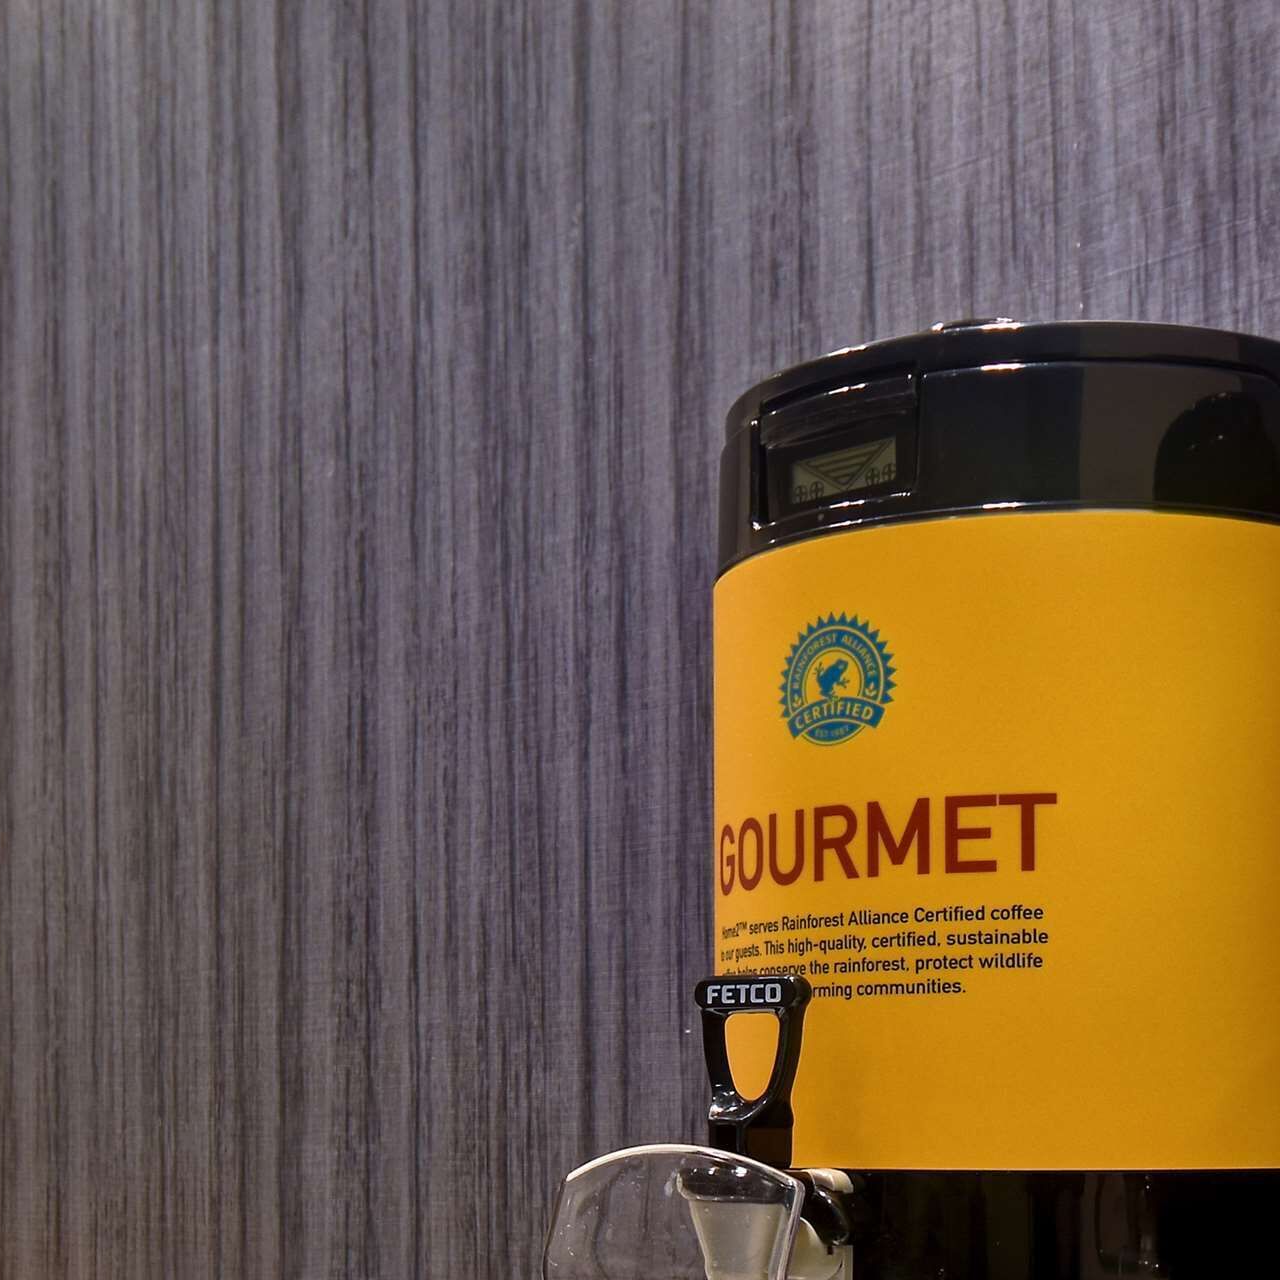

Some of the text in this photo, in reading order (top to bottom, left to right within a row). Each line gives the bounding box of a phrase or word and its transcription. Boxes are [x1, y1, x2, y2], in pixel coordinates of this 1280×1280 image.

[792, 633, 877, 689] RAINFOREST ALLIANCE
[794, 700, 874, 729] CERTIFIED
[720, 792, 1058, 896] GOURMET
[749, 919, 779, 934] serves
[782, 912, 844, 931] Rainforest
[848, 909, 909, 926] Alliance
[914, 905, 985, 923] Certified
[990, 904, 1044, 921] coffee
[725, 949, 735, 961] our
[735, 943, 762, 963] guests.
[764, 940, 785, 955] This
[788, 934, 867, 957] high-quality,
[871, 931, 941, 948] certified,
[946, 928, 1049, 946] sustainable
[760, 962, 806, 976] conserve
[809, 960, 830, 974] the
[833, 956, 909, 974] rainforest,
[915, 954, 973, 974] protect
[979, 952, 1043, 969] wildlife
[706, 983, 782, 1005] FETCO
[856, 978, 966, 996] communities.
